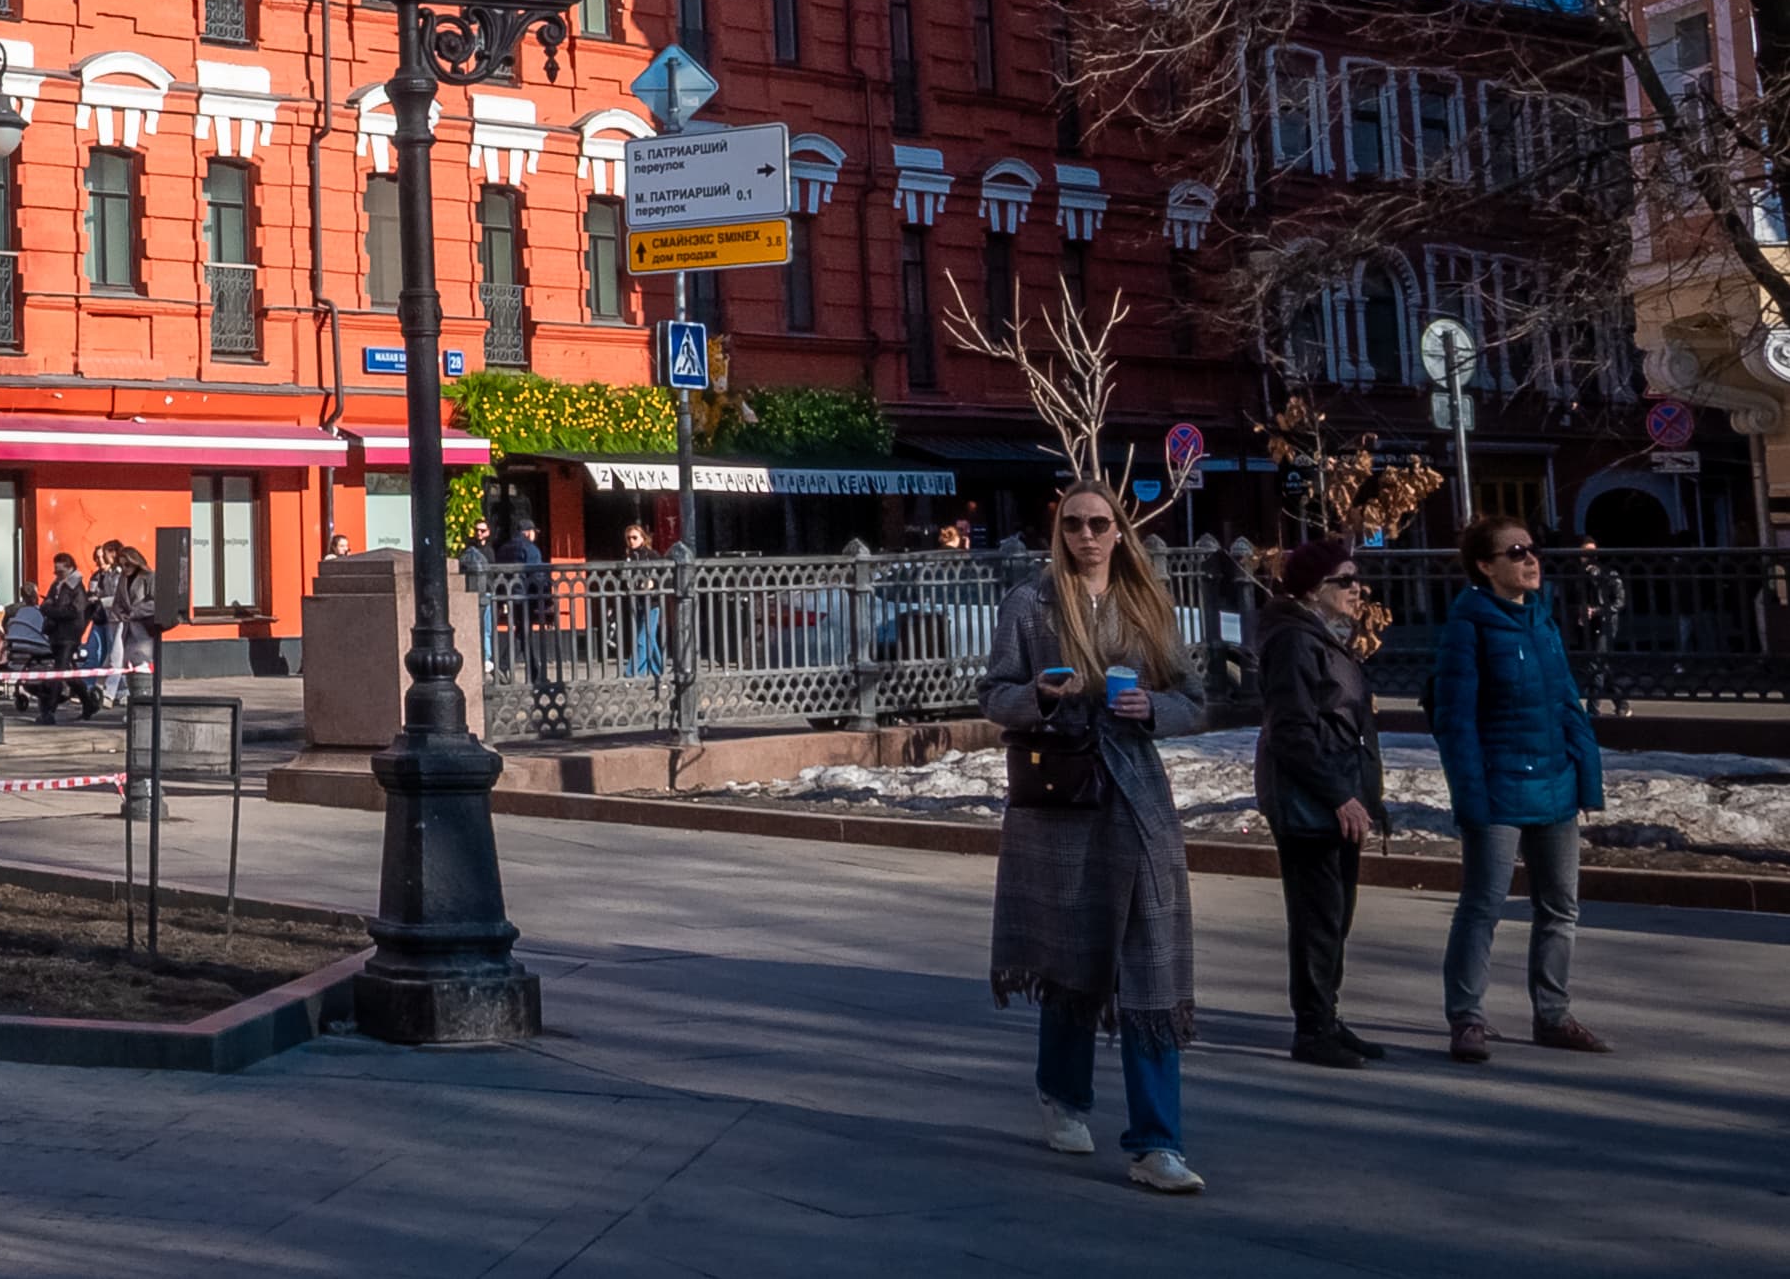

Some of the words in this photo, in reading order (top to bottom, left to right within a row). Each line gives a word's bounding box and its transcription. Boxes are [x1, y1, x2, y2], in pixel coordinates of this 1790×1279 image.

[633, 150, 646, 162] Б.
[647, 139, 728, 159] ПАТРИАРШИЙ
[634, 161, 685, 175] переулок
[635, 193, 648, 204] М.
[650, 182, 730, 202] ПАТРИАРШИЙ
[736, 188, 752, 201] 0.1
[635, 204, 687, 218] переулок
[652, 233, 714, 249] СМАЙНЭКС
[717, 230, 760, 244] SMINEX
[652, 254, 673, 265] дом
[677, 251, 717, 263] продаж
[450, 355, 462, 370] 28
